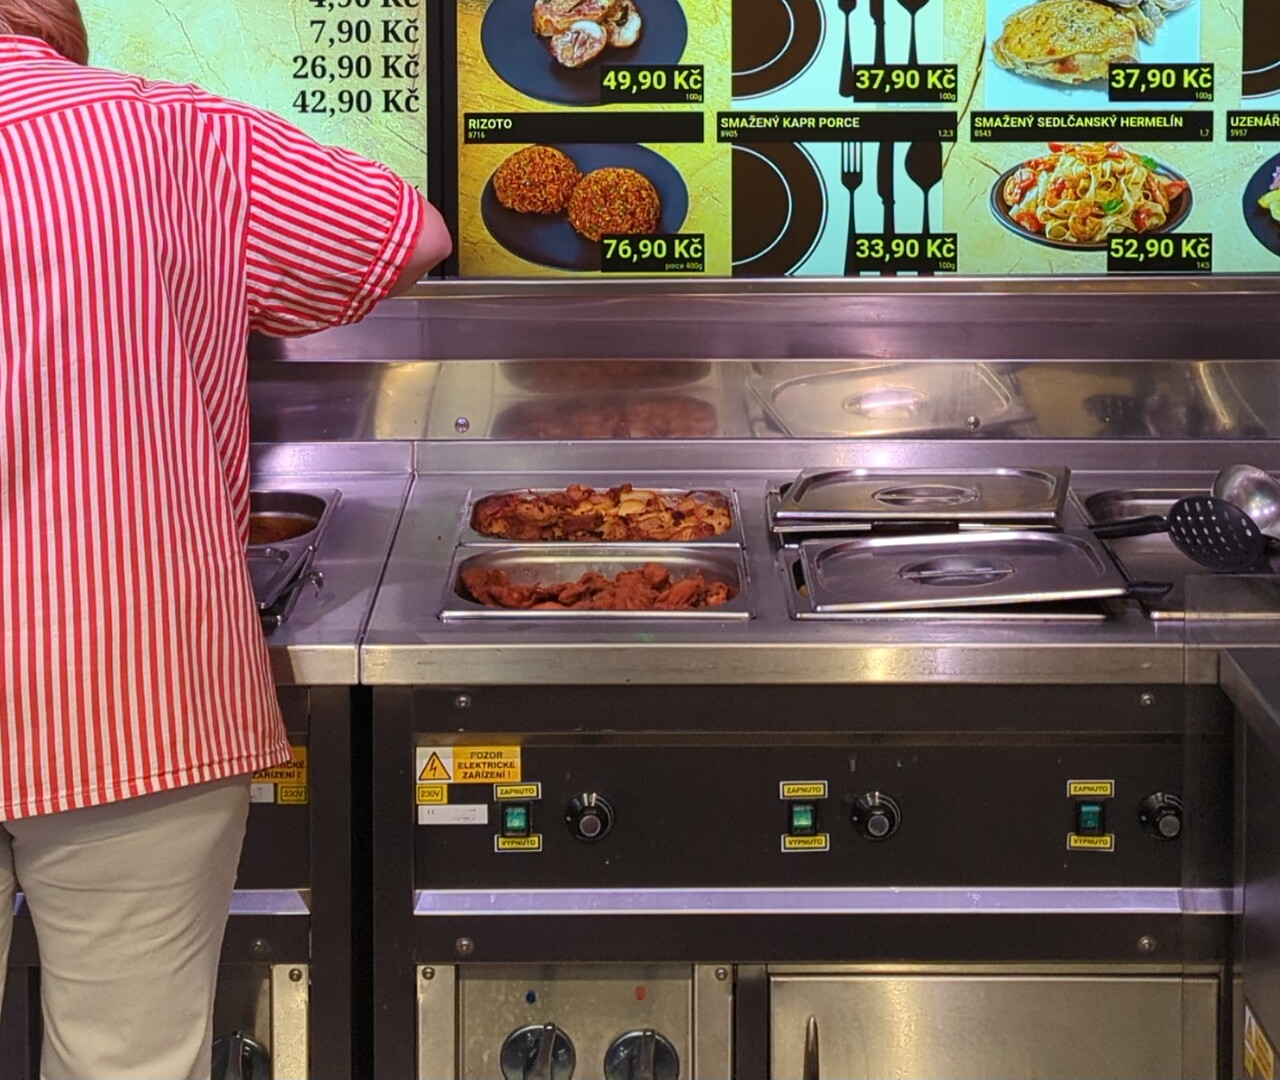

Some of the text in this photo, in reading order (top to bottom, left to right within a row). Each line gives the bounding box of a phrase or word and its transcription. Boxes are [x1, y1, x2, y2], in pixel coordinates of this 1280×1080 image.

[293, 53, 420, 83] 26,90 Kč
[601, 67, 703, 94] 49,90 Kč
[293, 88, 420, 116] 42,90 Kč
[467, 117, 514, 131] RIZOTO
